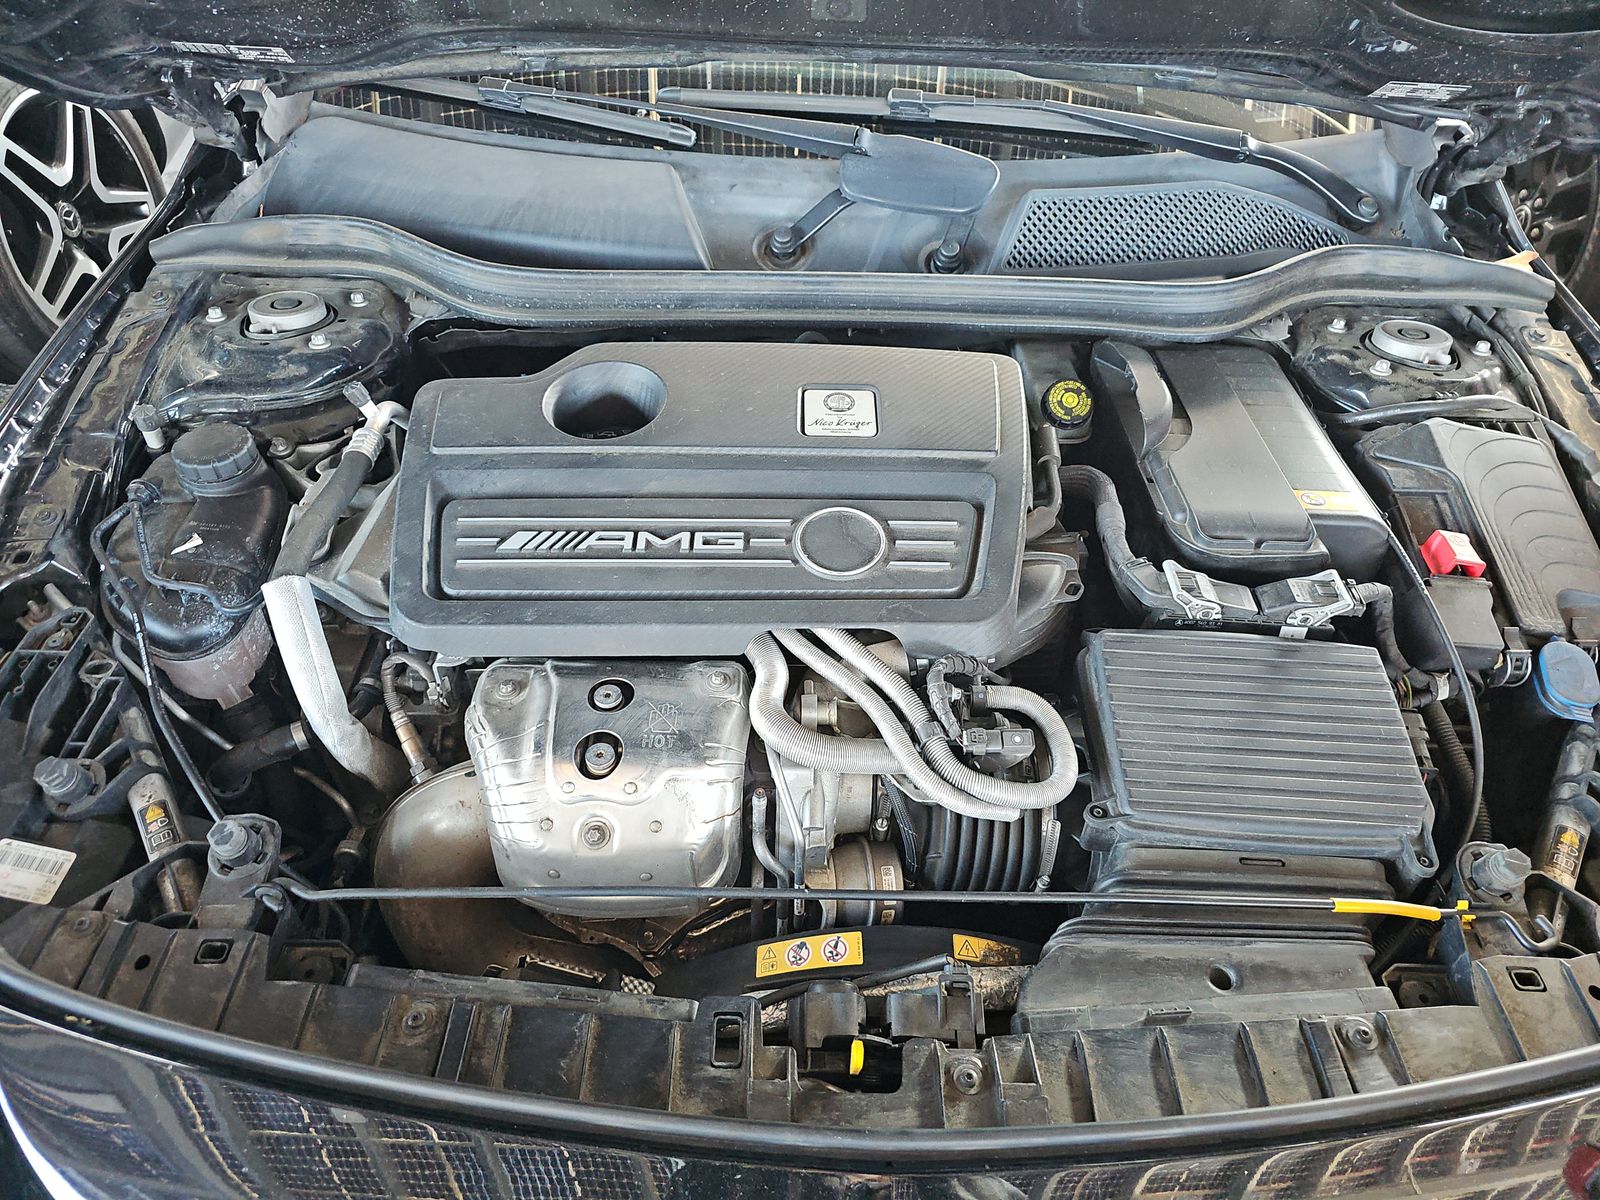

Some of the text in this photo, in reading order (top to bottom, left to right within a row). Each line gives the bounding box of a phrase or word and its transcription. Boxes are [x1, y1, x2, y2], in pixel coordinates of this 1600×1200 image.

[808, 418, 834, 427] Nico
[575, 531, 744, 553] AMG
[641, 734, 677, 748] HOT
